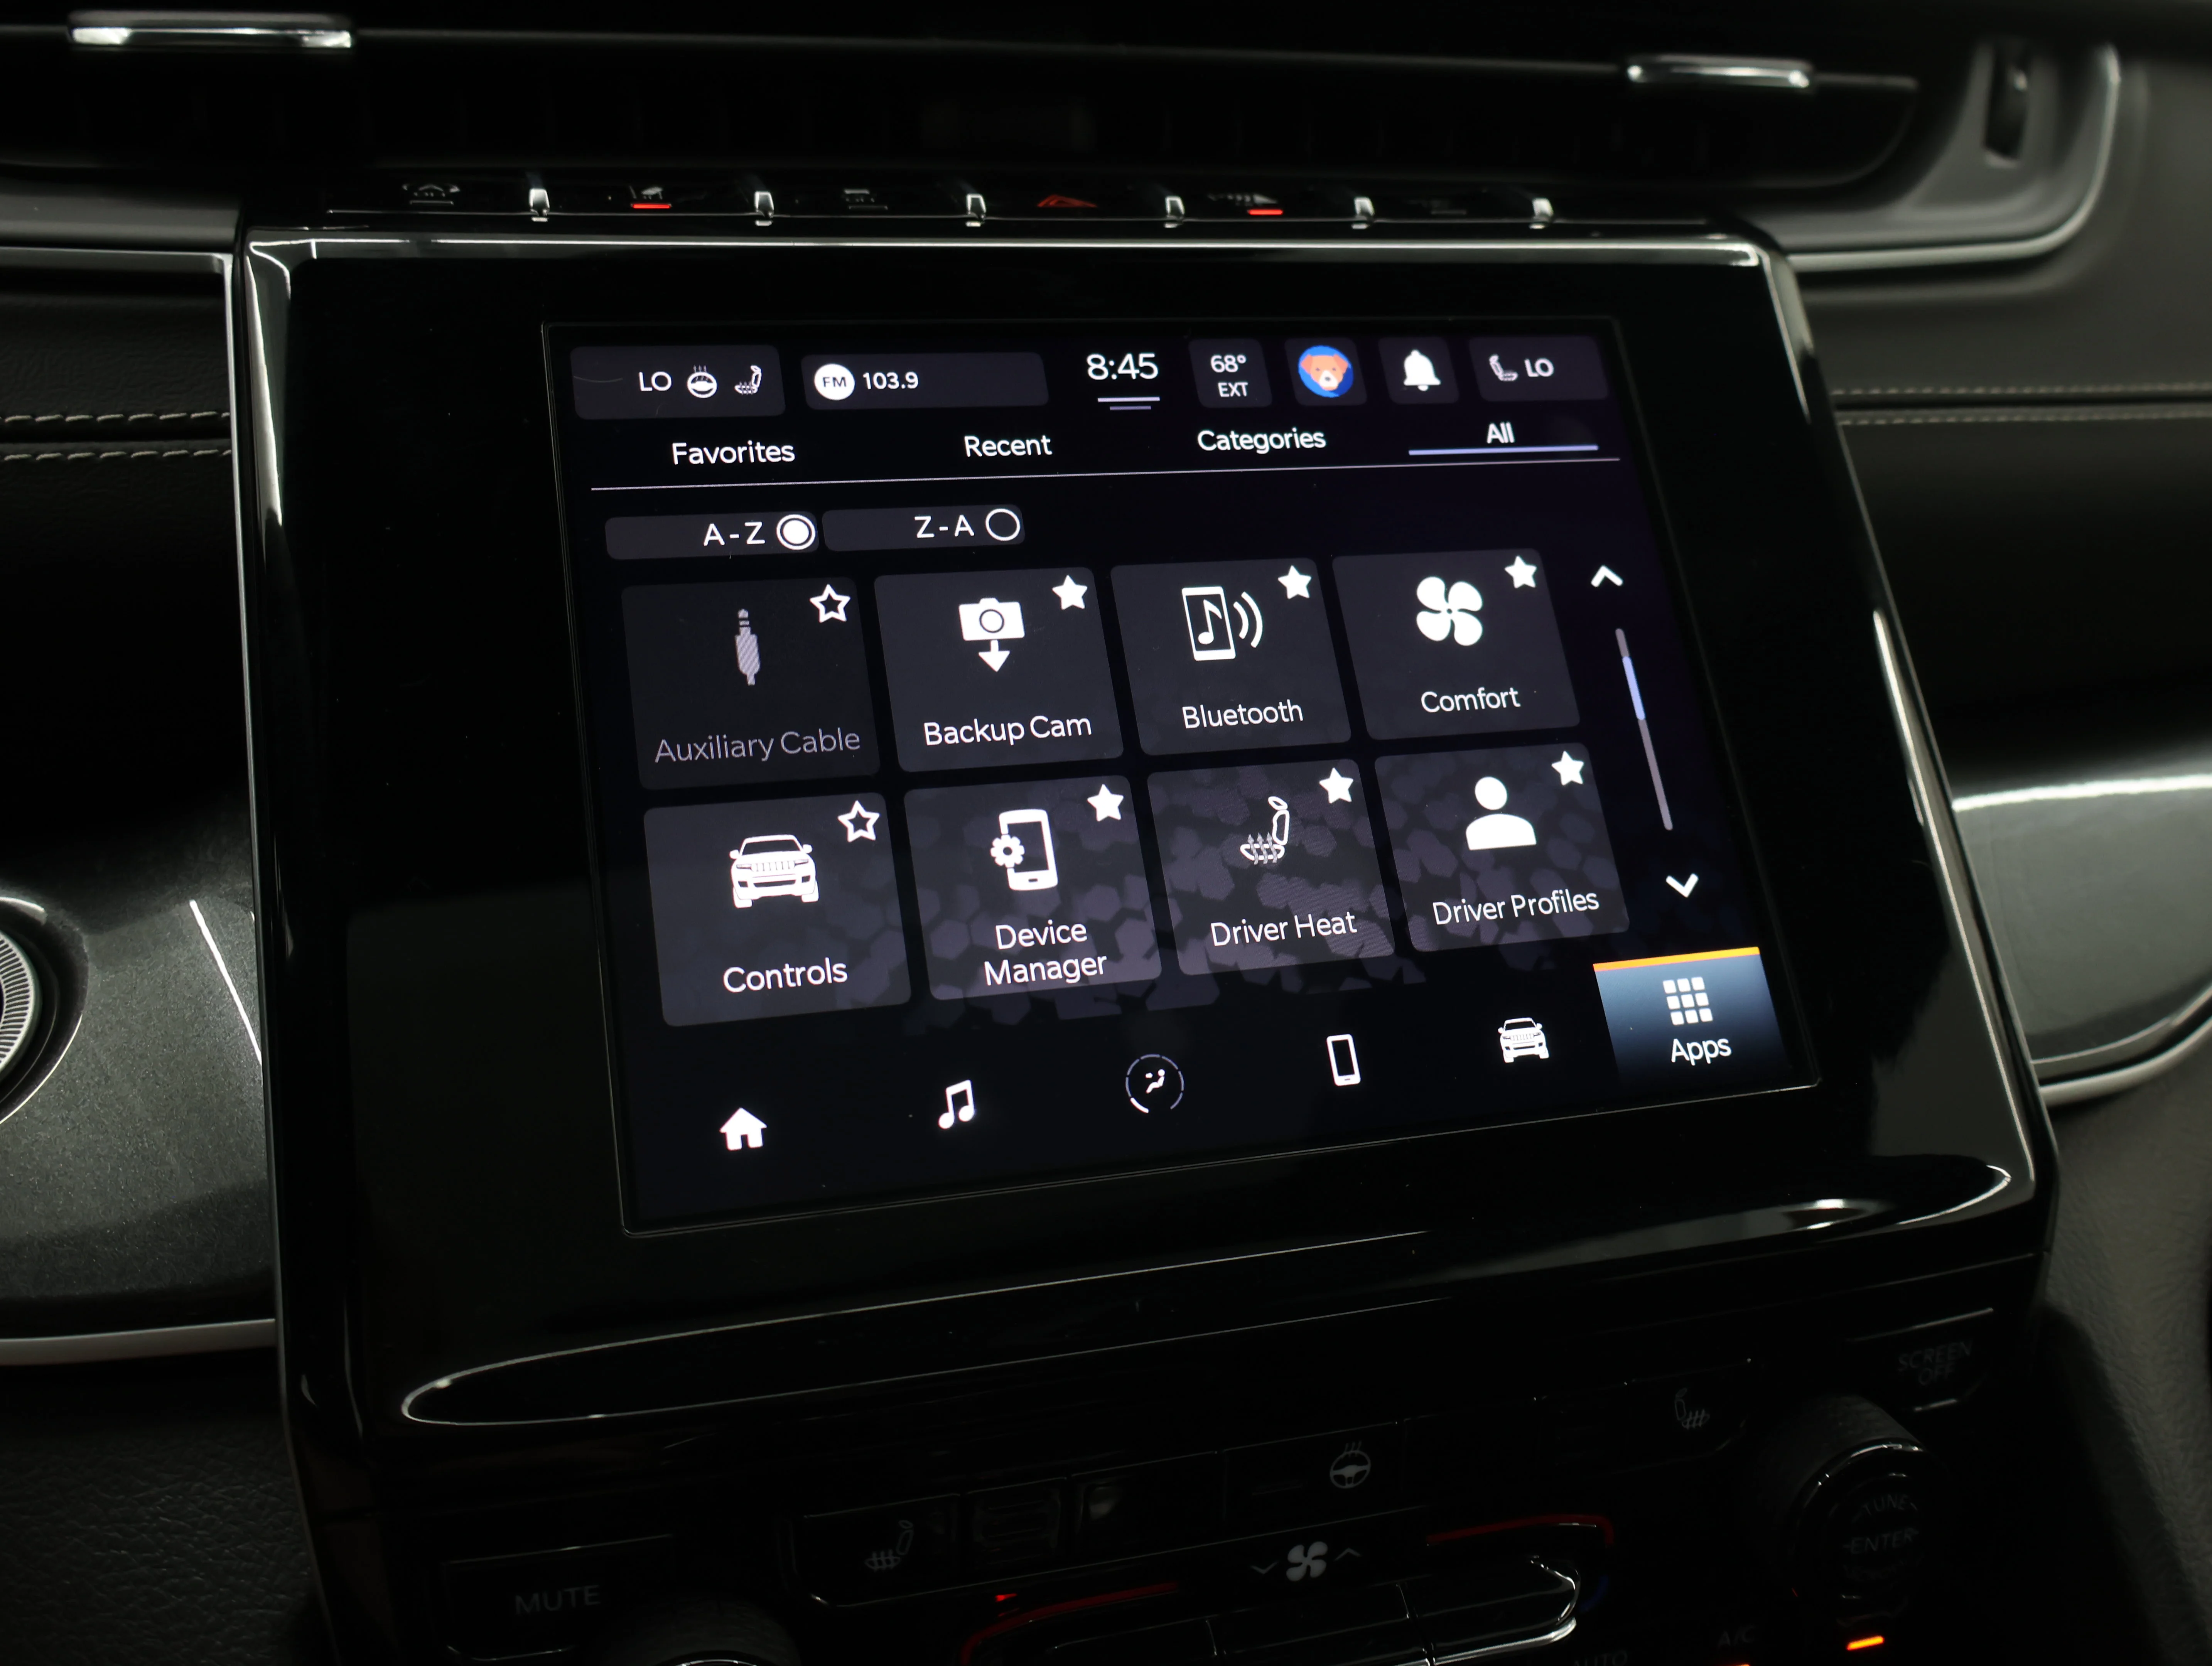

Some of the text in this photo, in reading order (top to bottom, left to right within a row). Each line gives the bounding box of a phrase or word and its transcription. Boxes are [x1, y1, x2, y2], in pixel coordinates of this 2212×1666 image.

[1086, 352, 1159, 380] 8:45
[1210, 354, 1247, 373] 68°
[1524, 358, 1554, 377] LO
[639, 371, 672, 391] LO
[822, 375, 847, 388] FM
[862, 371, 919, 390] 103.9
[1217, 381, 1248, 397] EXT
[1197, 427, 1327, 454] Categories
[1487, 422, 1514, 442] All
[672, 440, 795, 465] Favorites
[964, 435, 1053, 457] Recent
[1182, 699, 1304, 728] Bluetooth
[1421, 687, 1521, 713] Comfort
[655, 728, 861, 763] Auxiliary Cable
[924, 715, 1092, 749] Backup Cam
[1432, 889, 1600, 925] Driver Profiles
[995, 919, 1088, 949] Device
[1211, 912, 1358, 946] Driver Heat
[723, 957, 848, 993] Controls
[984, 953, 1107, 986] Manager
[1671, 1038, 1732, 1066] Apps
[1897, 1339, 1973, 1371] SCREEN
[515, 1584, 601, 1615] MUTE
[1718, 1624, 1755, 1648] A/C
